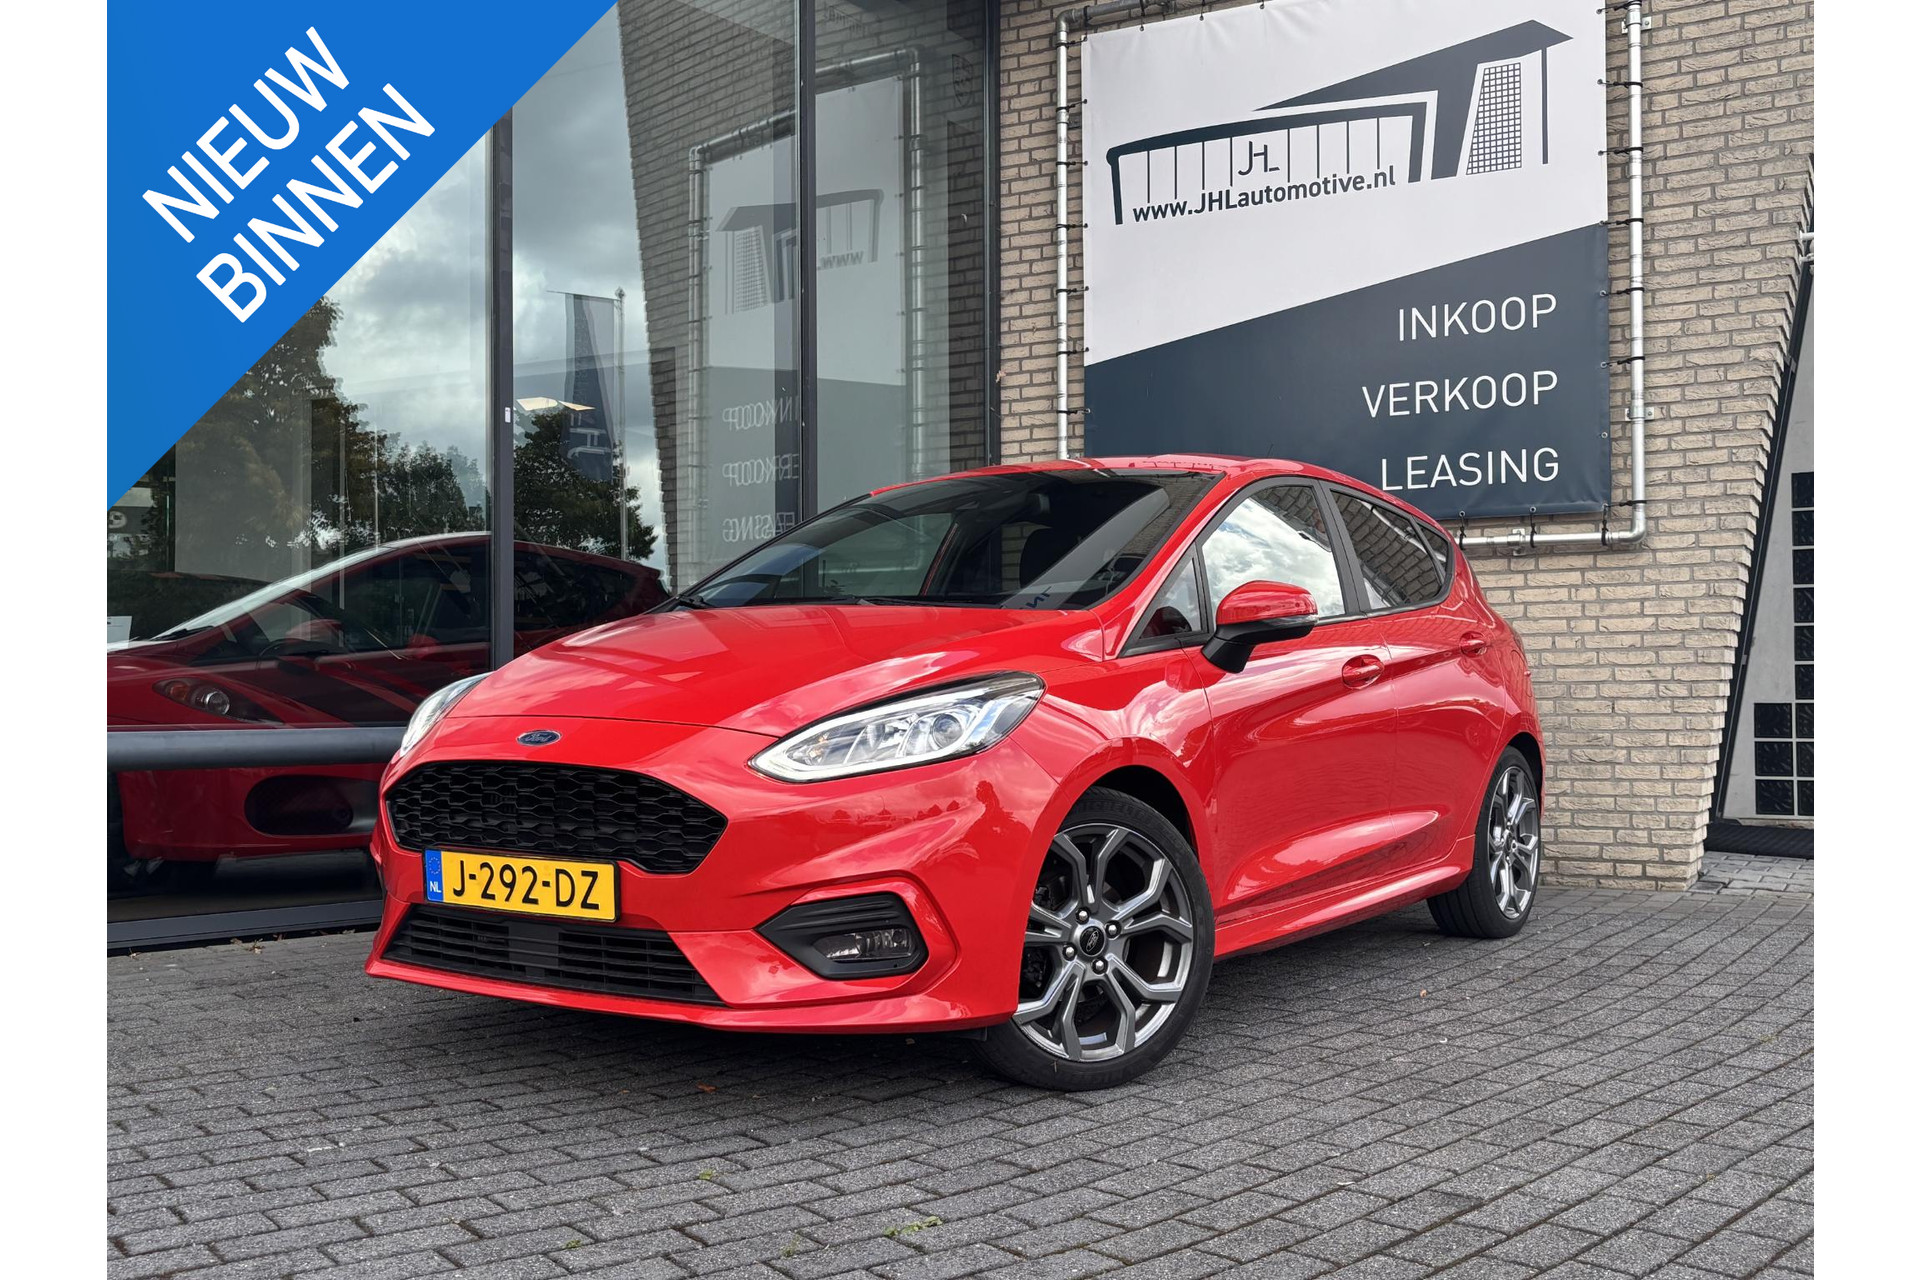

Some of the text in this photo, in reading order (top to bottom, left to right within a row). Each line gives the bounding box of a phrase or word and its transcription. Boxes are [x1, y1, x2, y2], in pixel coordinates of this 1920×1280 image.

[1132, 165, 1395, 222] www.JHLautomotive.nl
[1398, 294, 1557, 341] INKOOP
[1362, 370, 1558, 418] VERKOOP
[1382, 447, 1560, 491] LEASING
[430, 882, 442, 893] NL
[453, 860, 600, 910] J-292-DZ
